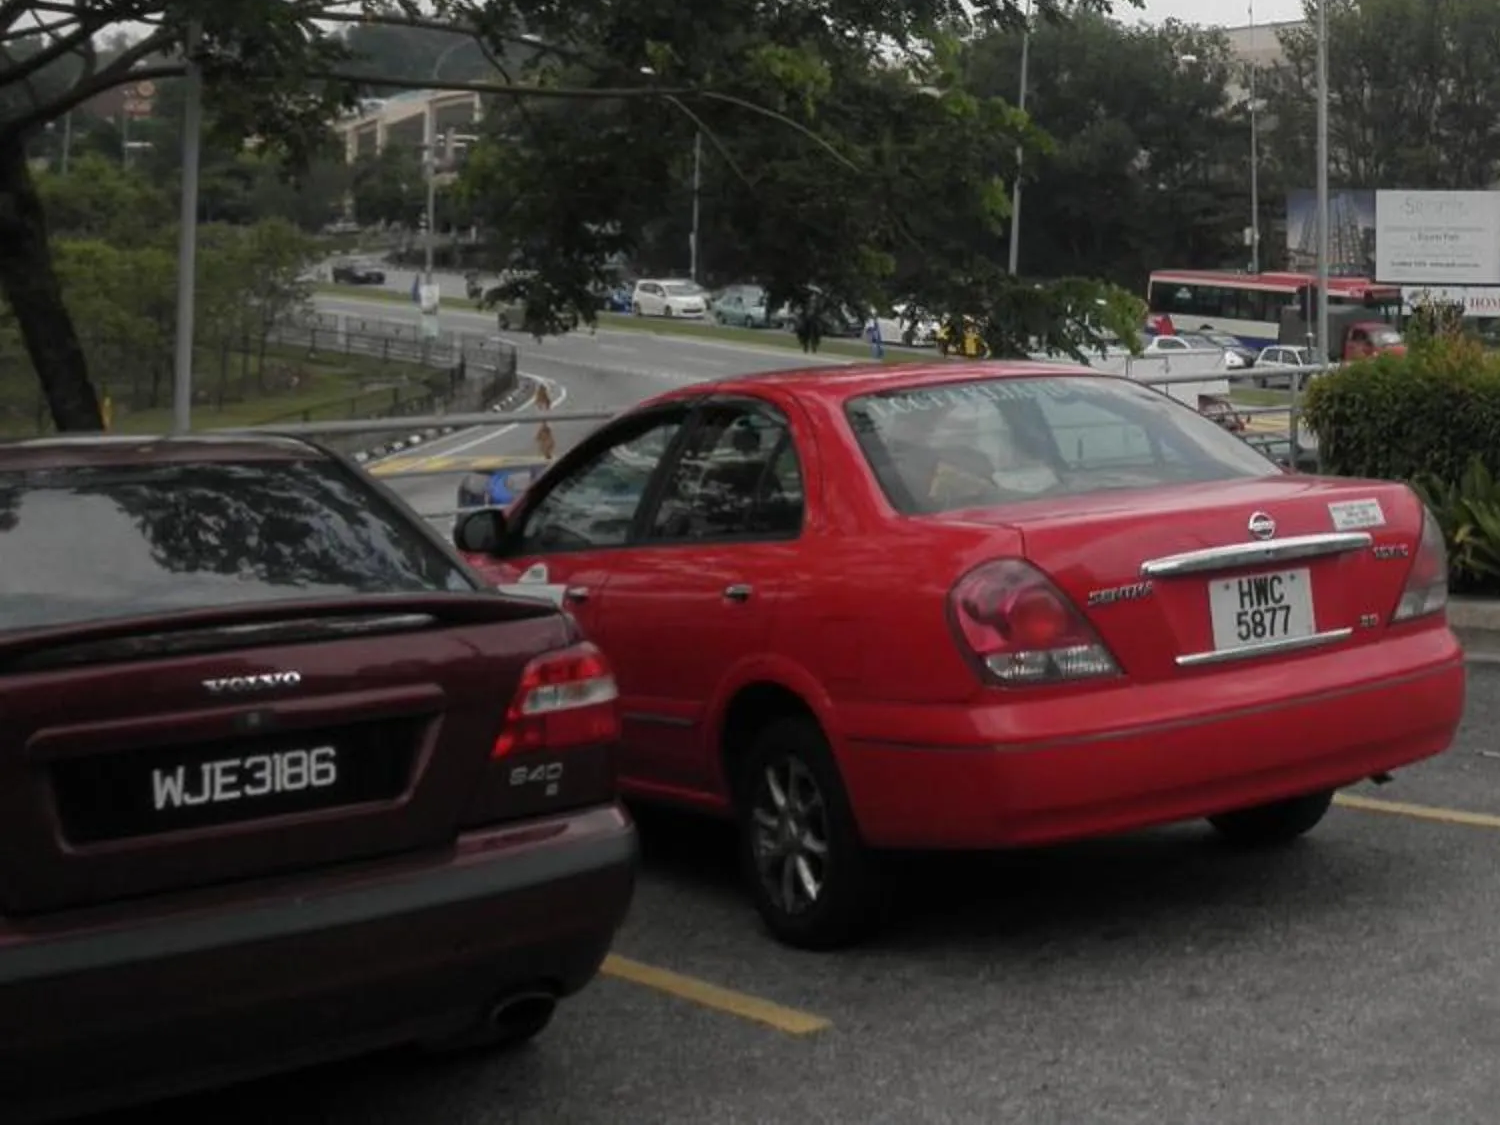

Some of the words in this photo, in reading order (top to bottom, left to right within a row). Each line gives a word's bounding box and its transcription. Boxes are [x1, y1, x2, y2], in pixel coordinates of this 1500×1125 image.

[1238, 575, 1285, 609] HWC
[1237, 605, 1291, 641] 5877
[201, 671, 301, 691] VOLVO
[152, 746, 337, 810] WJE3186
